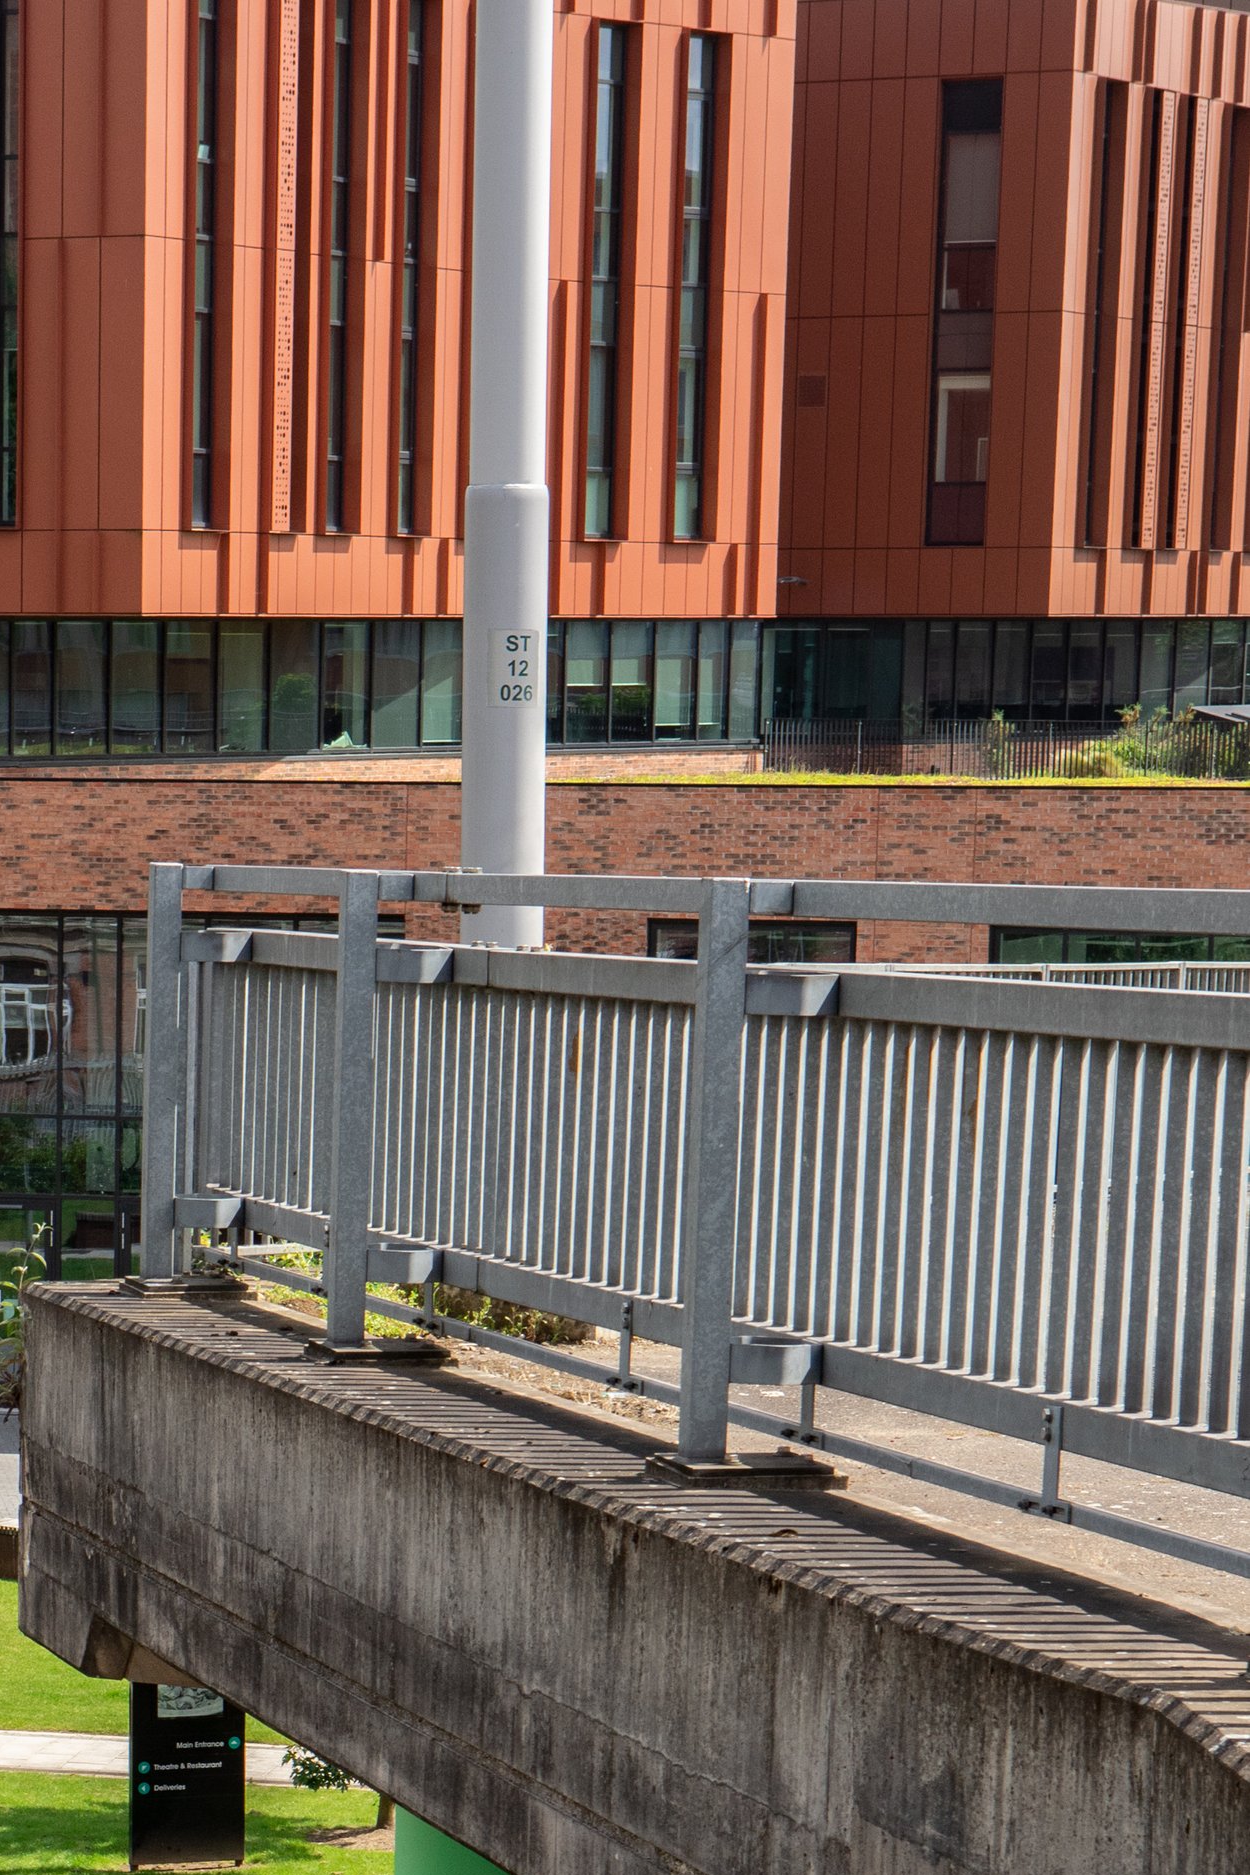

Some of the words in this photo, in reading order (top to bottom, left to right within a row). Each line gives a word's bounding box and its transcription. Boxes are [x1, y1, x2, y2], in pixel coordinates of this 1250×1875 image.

[506, 634, 532, 652] ST
[508, 659, 529, 677] 12
[500, 684, 533, 702] 026
[176, 1741, 194, 1749] Main
[195, 1740, 224, 1748] Entrance
[153, 1763, 179, 1771] Theatre
[187, 1761, 222, 1769] Restaurant
[153, 1784, 186, 1792] Deliveries
